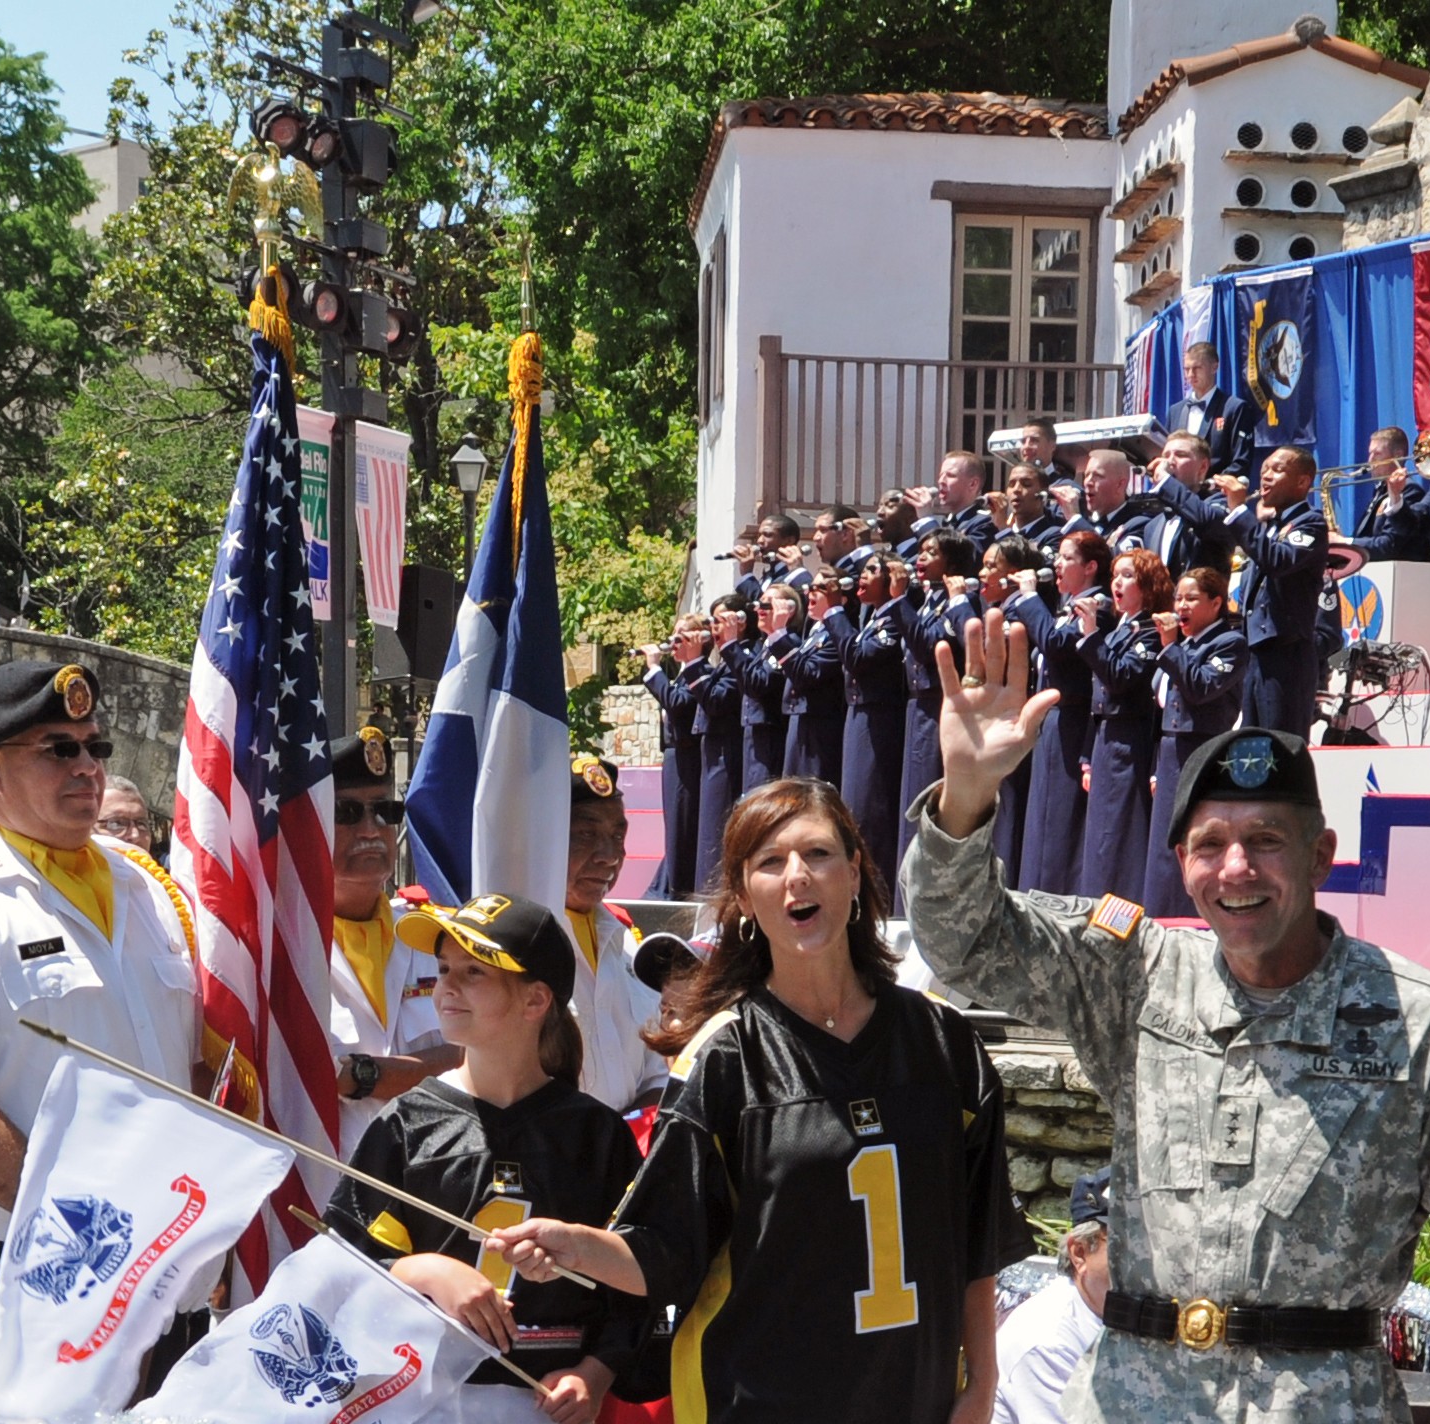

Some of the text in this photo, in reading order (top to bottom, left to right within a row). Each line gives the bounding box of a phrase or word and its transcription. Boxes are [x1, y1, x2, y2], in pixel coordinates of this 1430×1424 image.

[310, 580, 328, 602] ALK
[28, 942, 55, 955] MOYA
[1151, 1013, 1214, 1049] CALDWELL
[1313, 1057, 1399, 1077] U.S. ARMY
[847, 1143, 920, 1335] 1
